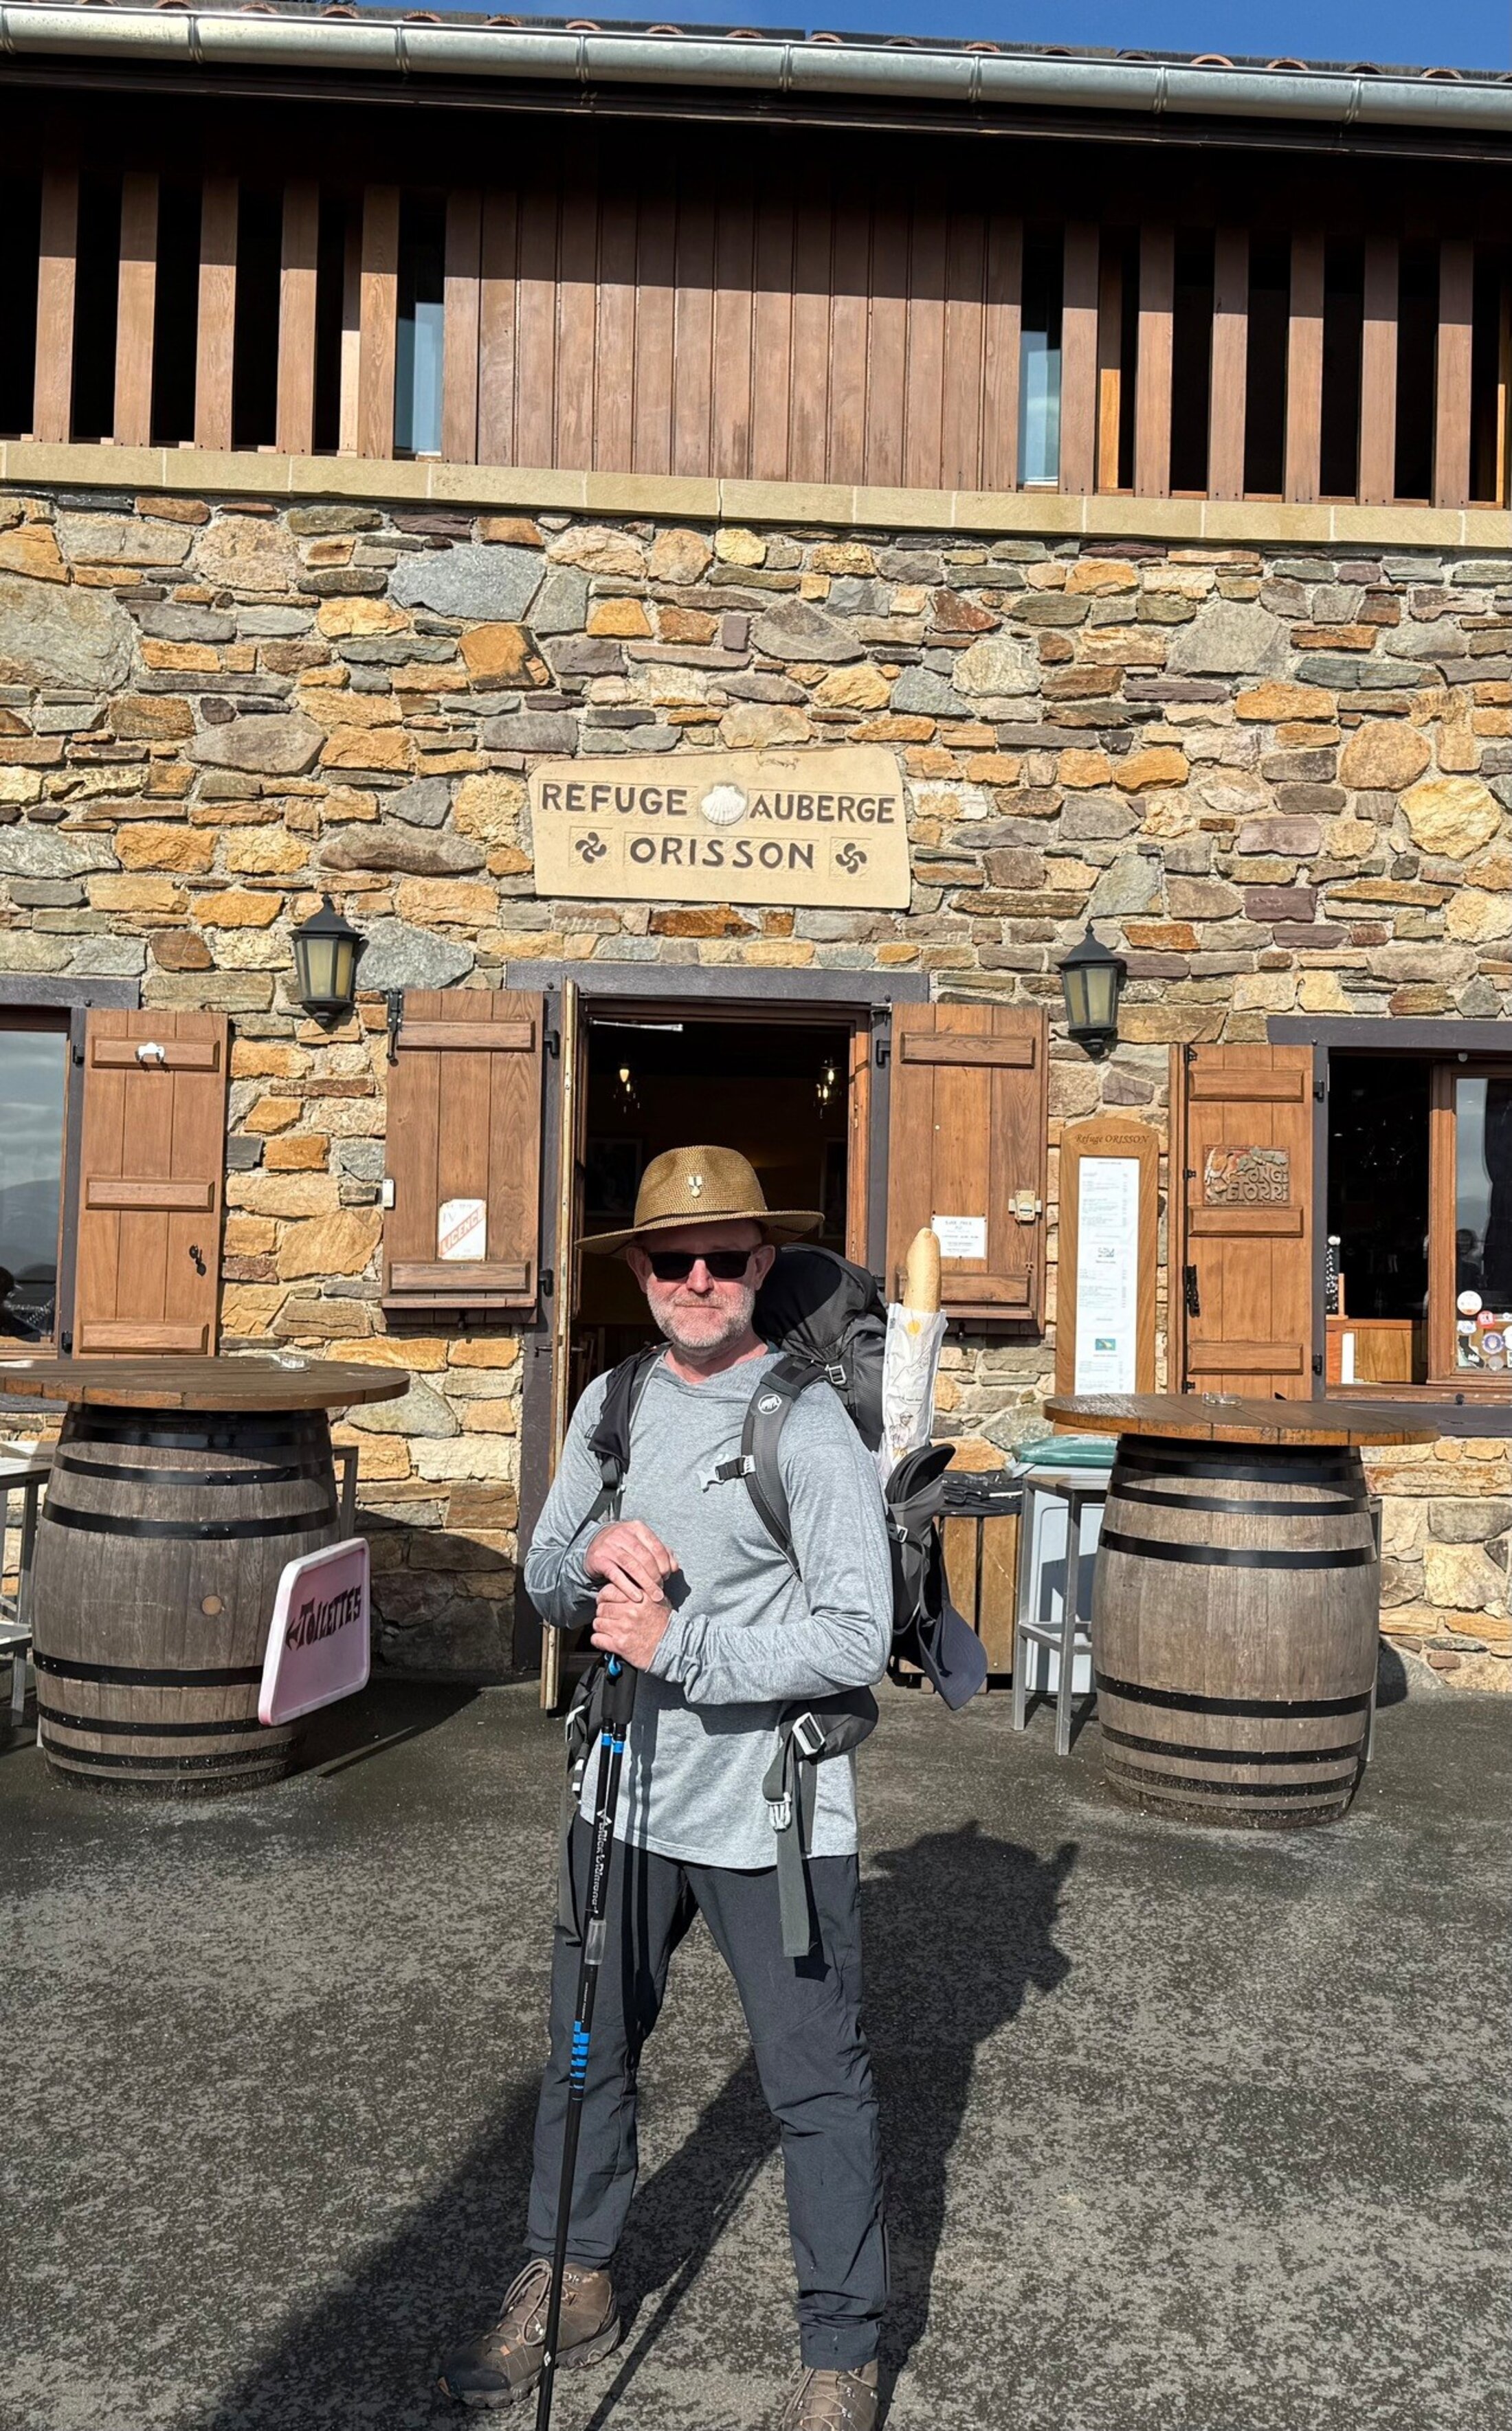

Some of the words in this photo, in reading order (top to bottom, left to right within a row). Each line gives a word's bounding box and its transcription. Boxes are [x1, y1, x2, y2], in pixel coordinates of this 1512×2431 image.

[542, 784, 688, 816] REFUGE
[748, 793, 895, 824] AUBERGE
[629, 837, 814, 869] ORISSON
[1105, 1134, 1149, 1144] ORISSON
[441, 1206, 484, 1255] LICENC
